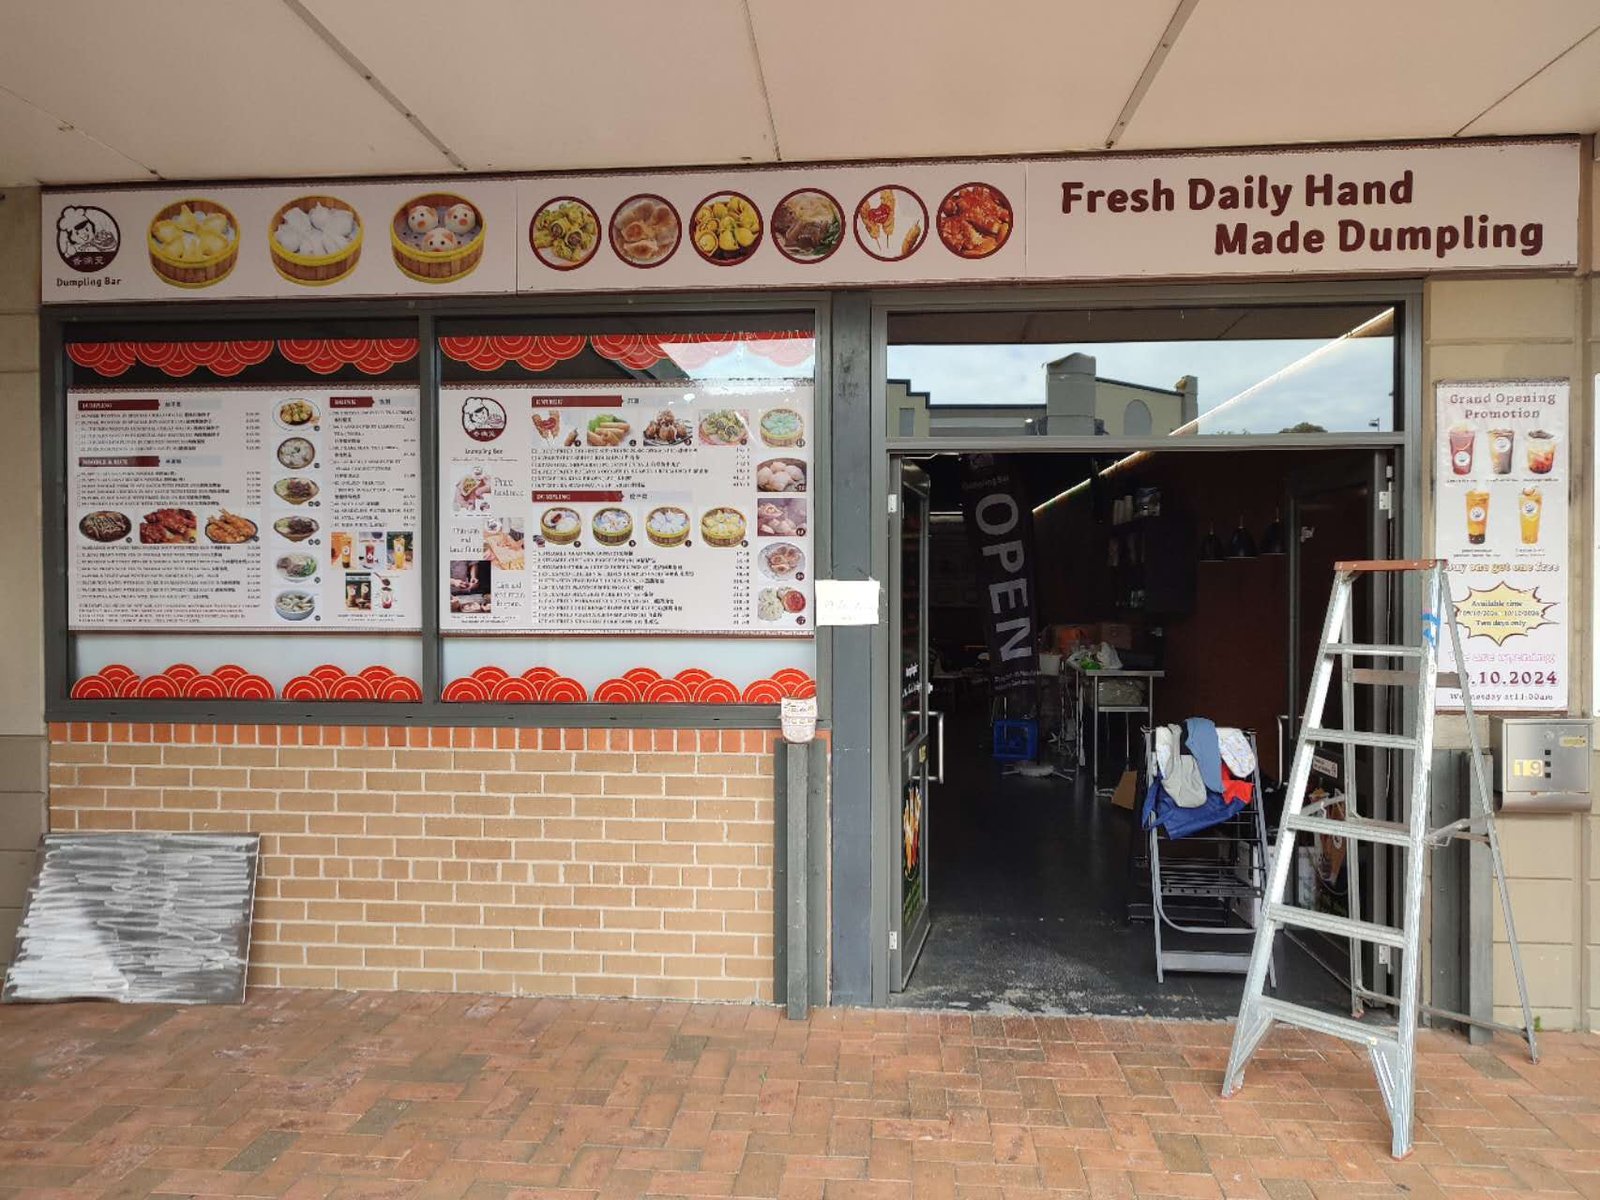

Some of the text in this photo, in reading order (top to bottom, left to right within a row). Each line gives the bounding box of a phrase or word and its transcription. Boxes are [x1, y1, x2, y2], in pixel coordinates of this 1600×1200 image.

[1061, 169, 1414, 217] Fresh Daily Hand
[1214, 213, 1544, 258] Made Dumpling
[56, 276, 121, 289] Dumpling Bar
[1450, 393, 1556, 406] Grand Opening
[1465, 408, 1540, 419] Promotion
[975, 493, 1032, 662] OPEN
[1509, 620, 1527, 628] only
[1456, 670, 1558, 686] .10.2024
[1513, 759, 1542, 777] 19
